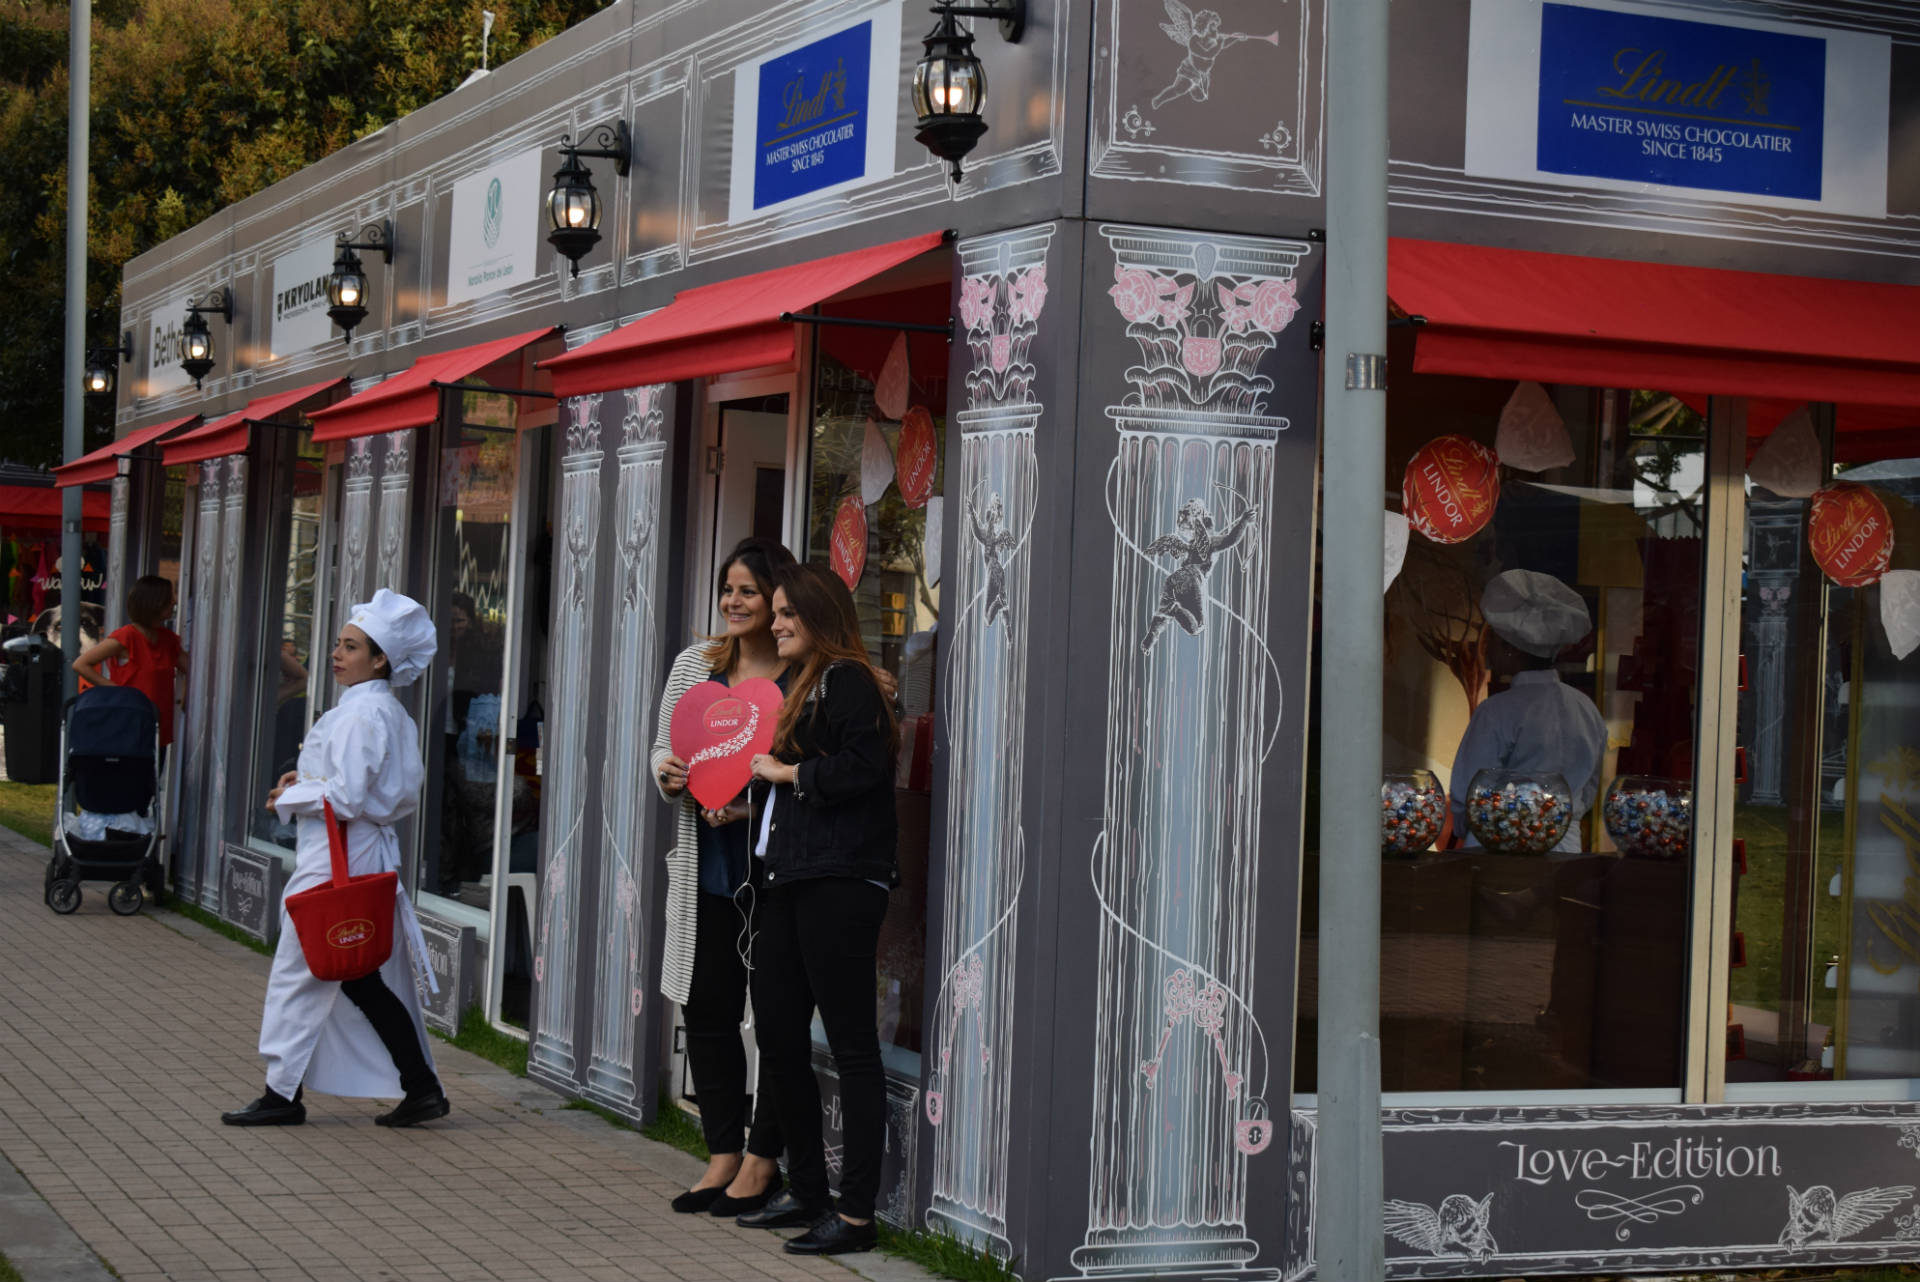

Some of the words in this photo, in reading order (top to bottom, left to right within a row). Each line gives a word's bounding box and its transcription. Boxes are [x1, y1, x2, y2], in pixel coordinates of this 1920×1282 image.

[1596, 47, 1738, 110] Lindt
[776, 72, 833, 130] Lindt
[766, 146, 790, 166] MASTER
[790, 138, 808, 159] SWISS
[808, 123, 854, 151] CHOCOLATIER
[1571, 112, 1633, 135] MASTER
[1636, 120, 1681, 141] SWISS
[1684, 126, 1792, 153] CHOCOLATIER
[1641, 139, 1687, 159] SINCE
[1691, 145, 1722, 163] 1845
[791, 154, 810, 173] SINCE
[811, 150, 825, 167] 1845
[1422, 463, 1463, 528] LINDOR
[1834, 516, 1880, 569] LINDOR
[711, 718, 738, 728] LINDOR
